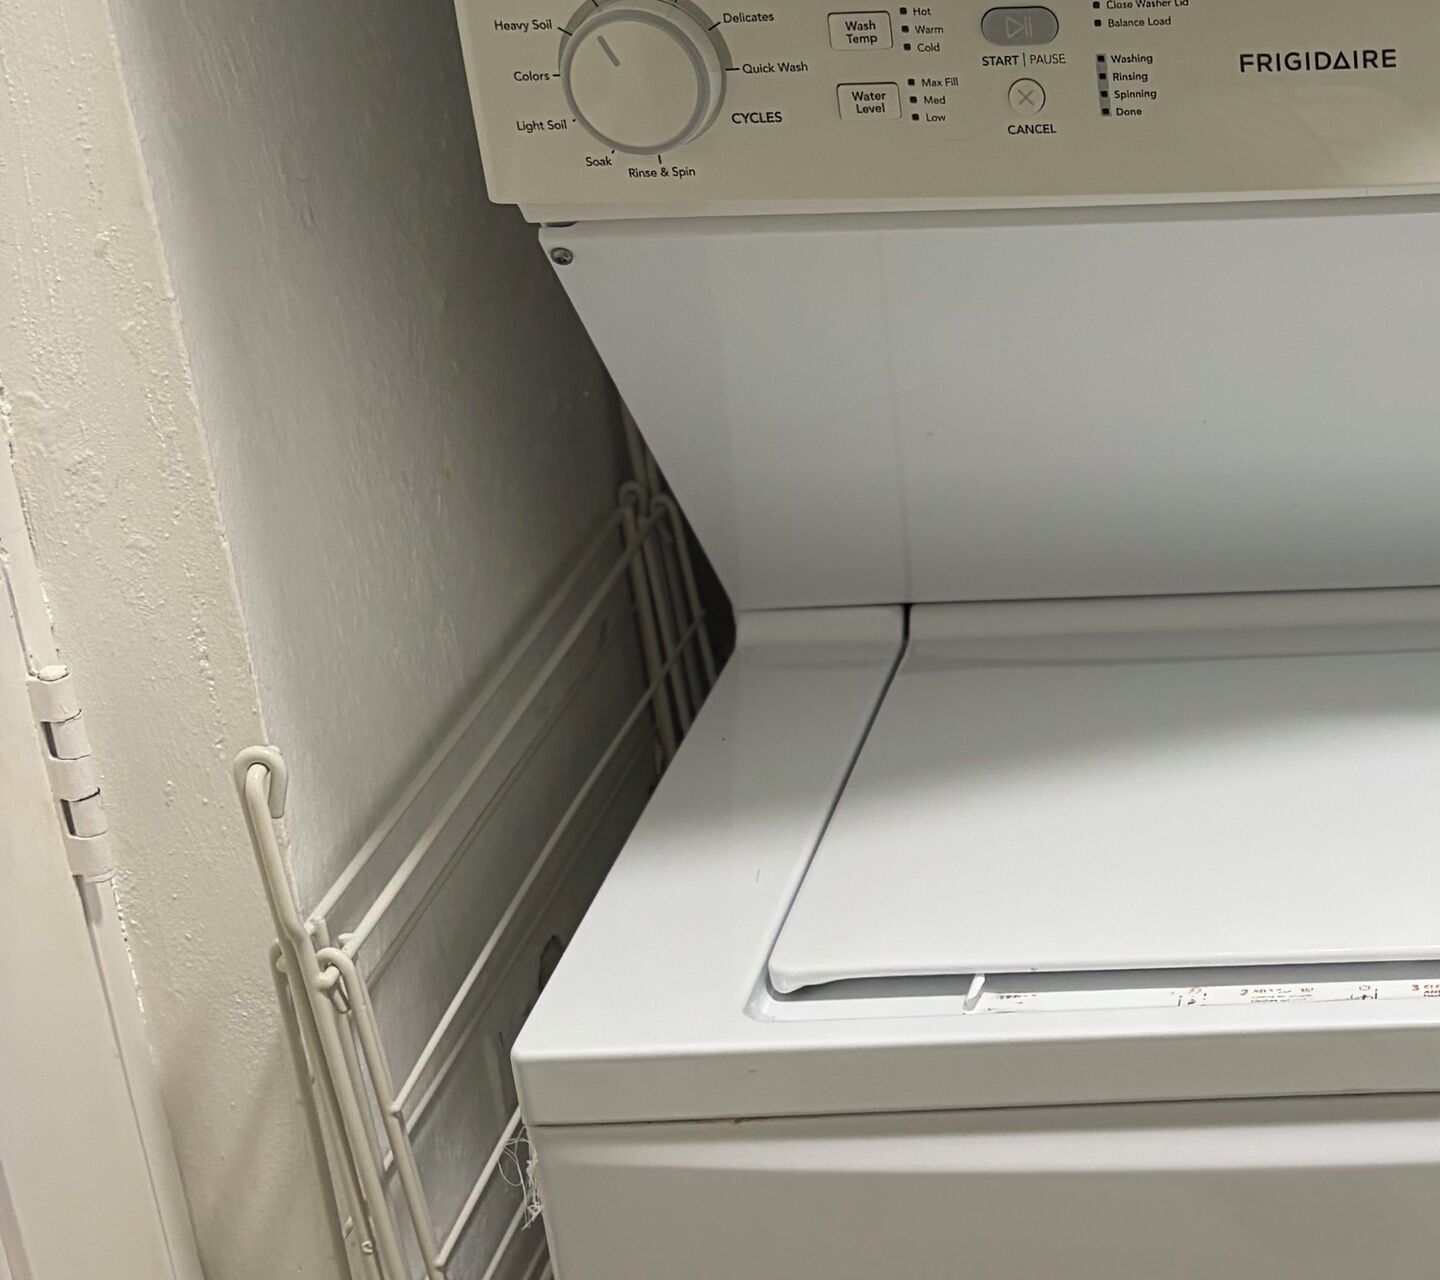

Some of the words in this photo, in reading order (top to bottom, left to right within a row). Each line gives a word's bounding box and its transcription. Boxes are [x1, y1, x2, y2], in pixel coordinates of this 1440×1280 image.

[1105, 0, 1132, 10] Close
[913, 7, 932, 16] Hot
[723, 12, 774, 24] Delicates
[1107, 17, 1145, 28] Balance
[1147, 16, 1171, 26] Load
[494, 21, 529, 32] Heavy
[532, 19, 552, 30] Soil
[845, 20, 876, 32] Wash
[915, 25, 944, 34] Warm
[846, 33, 878, 45] Temp
[917, 42, 940, 52] Cold
[981, 55, 1019, 66] START
[1029, 53, 1066, 64] PAUSE
[1110, 53, 1153, 65] Washing
[1239, 49, 1396, 72] FRIGIDAIRE
[742, 63, 774, 75] Quick
[777, 62, 808, 73] Wash
[513, 70, 550, 82] Colors
[1112, 71, 1148, 83] Rinsing
[921, 78, 943, 88] Max
[944, 77, 959, 86] Fill
[852, 91, 886, 102] Water
[923, 96, 946, 105] Med
[1114, 88, 1157, 101] Spinning
[856, 103, 886, 114] Level
[1116, 107, 1142, 117] Done
[731, 112, 783, 124] CYCLES
[926, 113, 946, 122] Low
[516, 121, 545, 133] Light
[547, 120, 567, 131] Soil
[1007, 124, 1056, 135] CANCEL
[585, 156, 612, 167] Soak
[628, 168, 657, 179] Rinse
[660, 168, 670, 178] &
[672, 166, 696, 180] Spin
